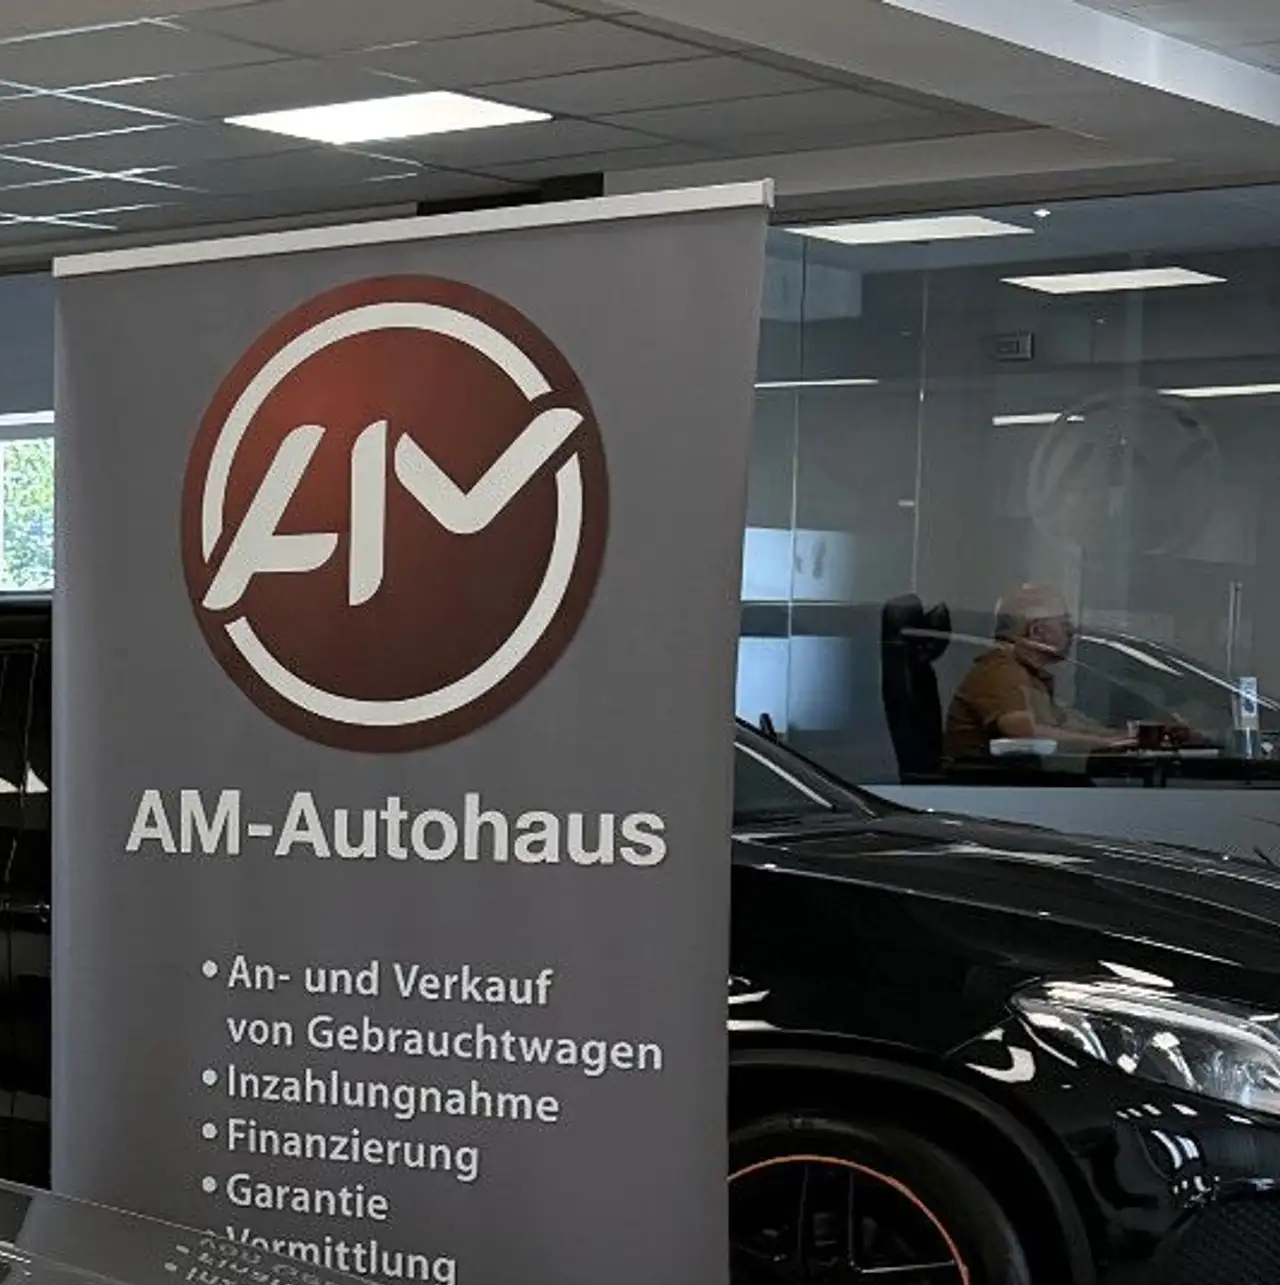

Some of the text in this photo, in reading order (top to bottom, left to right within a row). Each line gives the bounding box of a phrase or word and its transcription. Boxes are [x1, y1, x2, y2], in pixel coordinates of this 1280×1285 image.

[125, 788, 668, 866] AM-Autohaus
[228, 955, 554, 1005] An- und Verkauf
[226, 1014, 663, 1077] von Gebrauchtwagen
[228, 1064, 560, 1122] Inzahlungnahme
[227, 1118, 480, 1182] Finanzierung
[226, 1173, 389, 1220] Garantie
